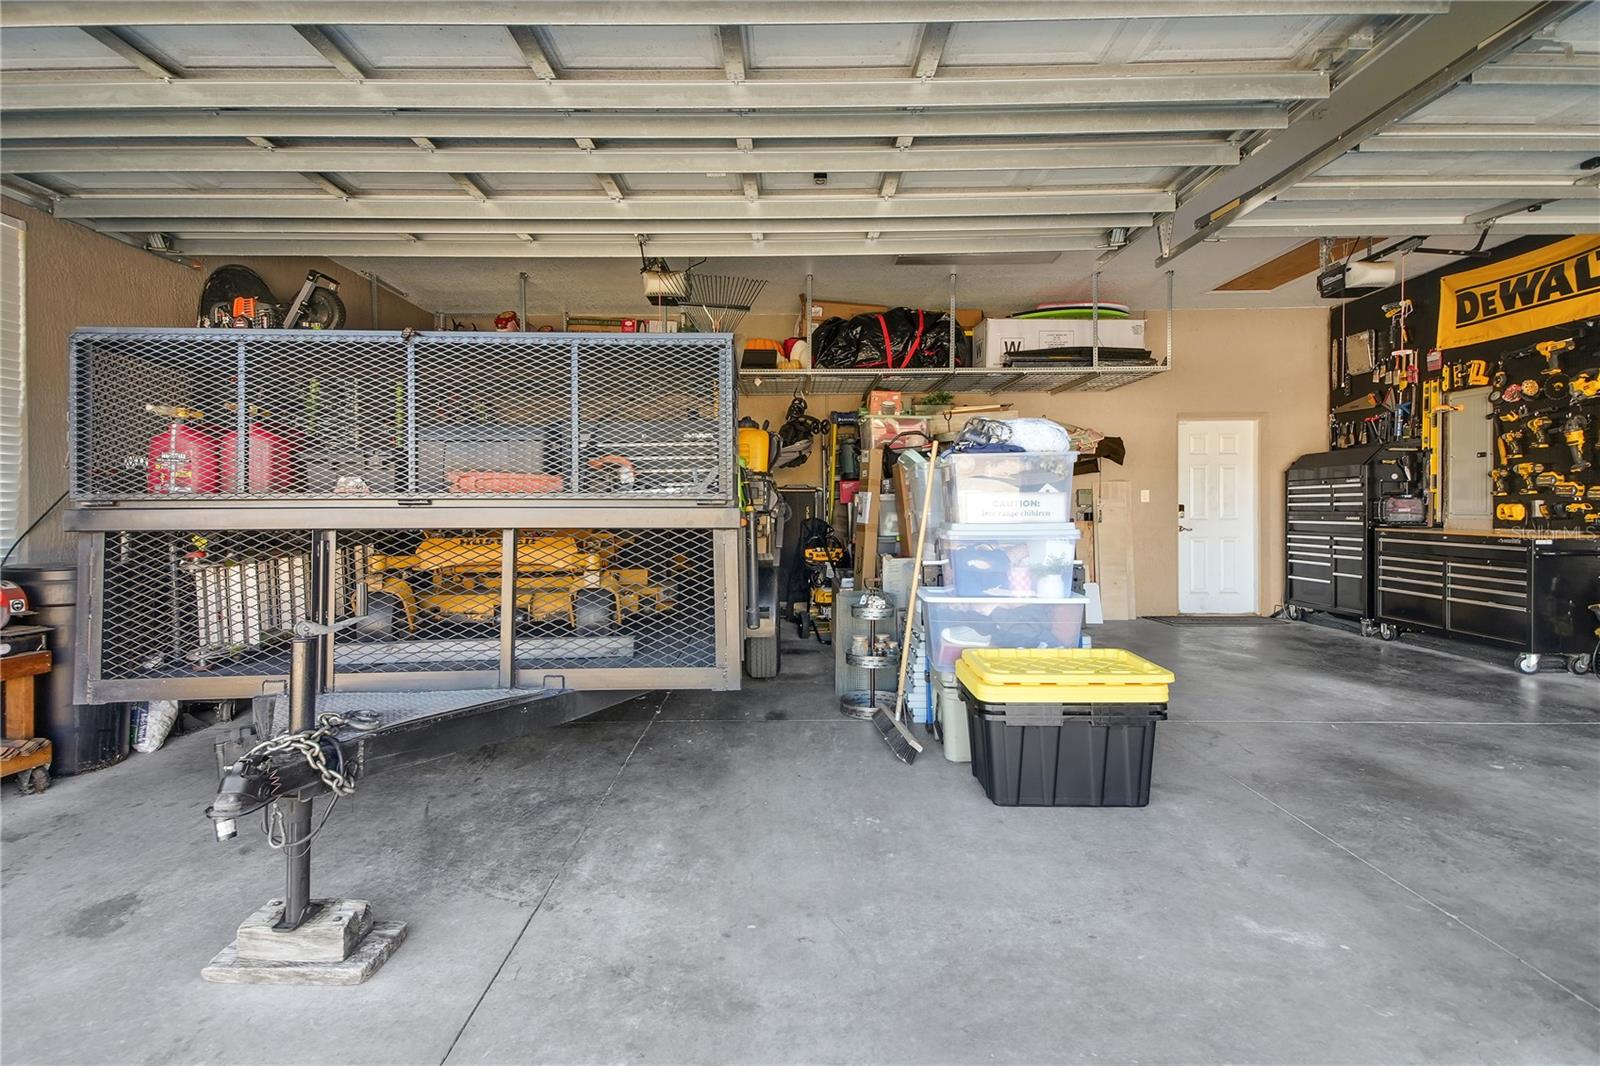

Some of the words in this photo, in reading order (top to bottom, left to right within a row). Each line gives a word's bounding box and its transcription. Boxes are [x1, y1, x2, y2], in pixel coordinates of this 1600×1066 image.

[1456, 250, 1600, 324] DEWAL
[992, 499, 1041, 508] CAUTION:
[1021, 509, 1051, 517] children
